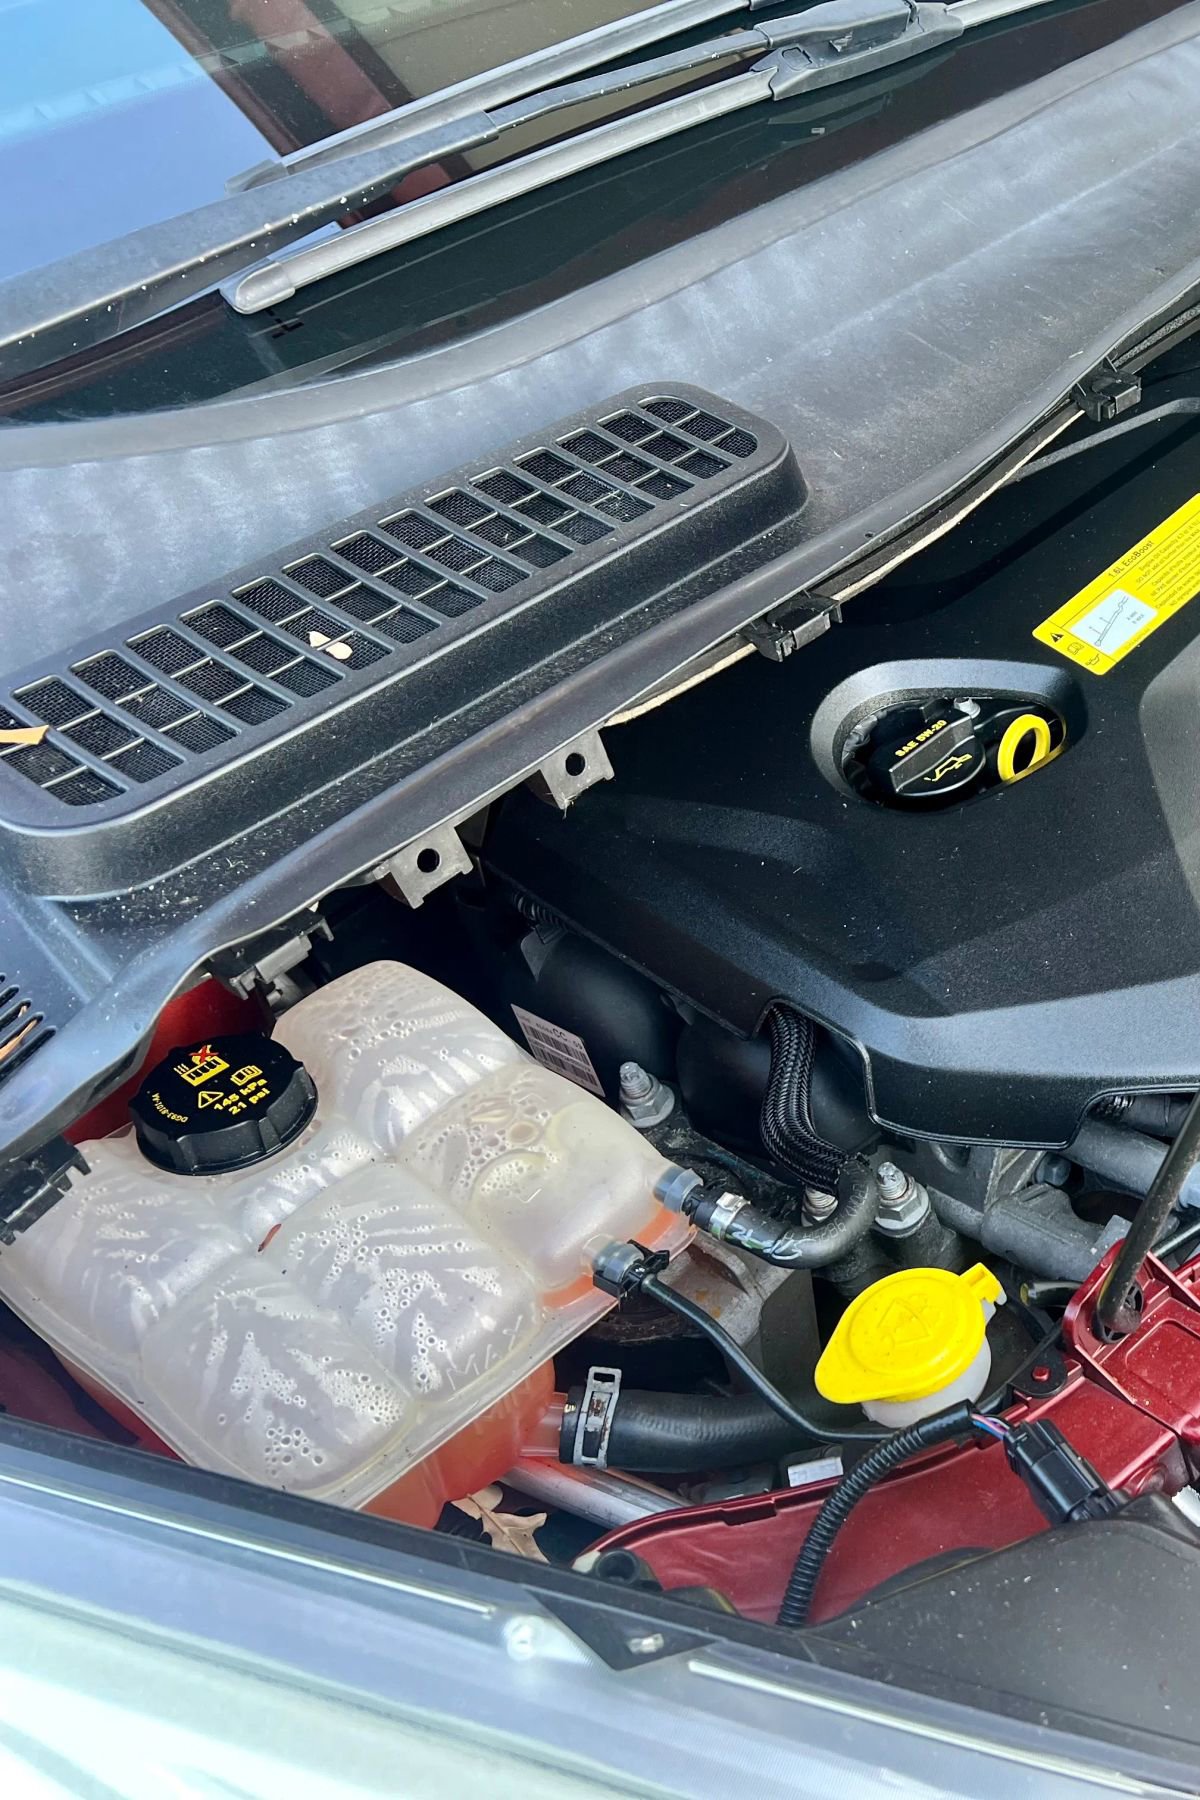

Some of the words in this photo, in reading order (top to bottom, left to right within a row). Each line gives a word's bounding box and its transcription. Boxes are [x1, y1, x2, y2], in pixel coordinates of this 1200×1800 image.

[1121, 539, 1155, 567] EcoBoost
[895, 736, 919, 757] SAE
[919, 719, 947, 742] 5W-20
[213, 1094, 240, 1110] 145
[239, 1078, 268, 1096] kPa
[228, 1101, 247, 1115] 21
[248, 1088, 271, 1104] psi
[446, 1314, 524, 1391] MAX
